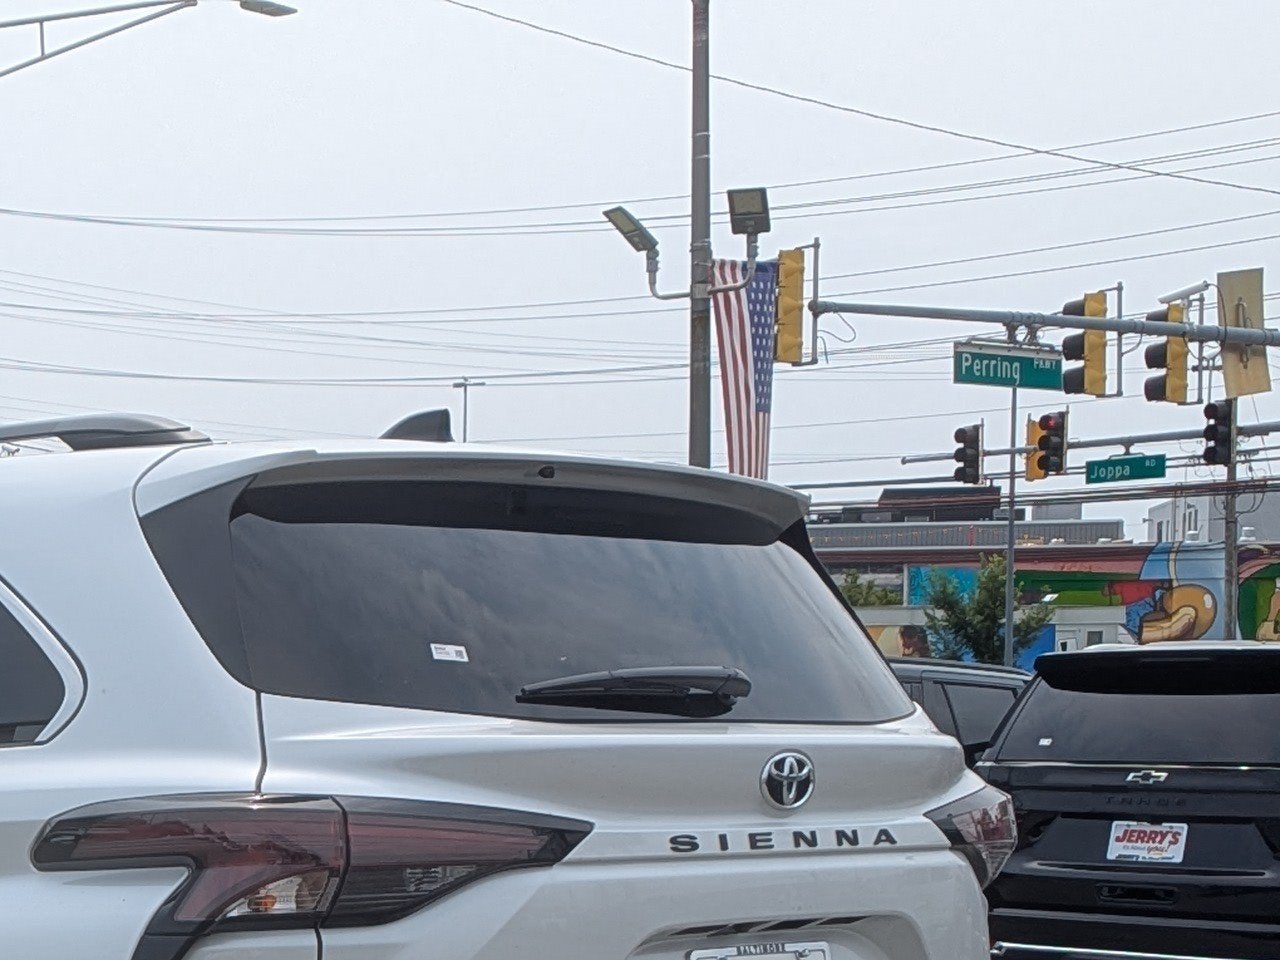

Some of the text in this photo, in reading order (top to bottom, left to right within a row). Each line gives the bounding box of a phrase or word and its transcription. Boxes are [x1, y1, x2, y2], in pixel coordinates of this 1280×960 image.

[961, 353, 1020, 385] Perring
[1090, 459, 1156, 480] Joppa RD
[669, 828, 898, 853] SIENNA
[1114, 828, 1182, 846] JERRY'S
